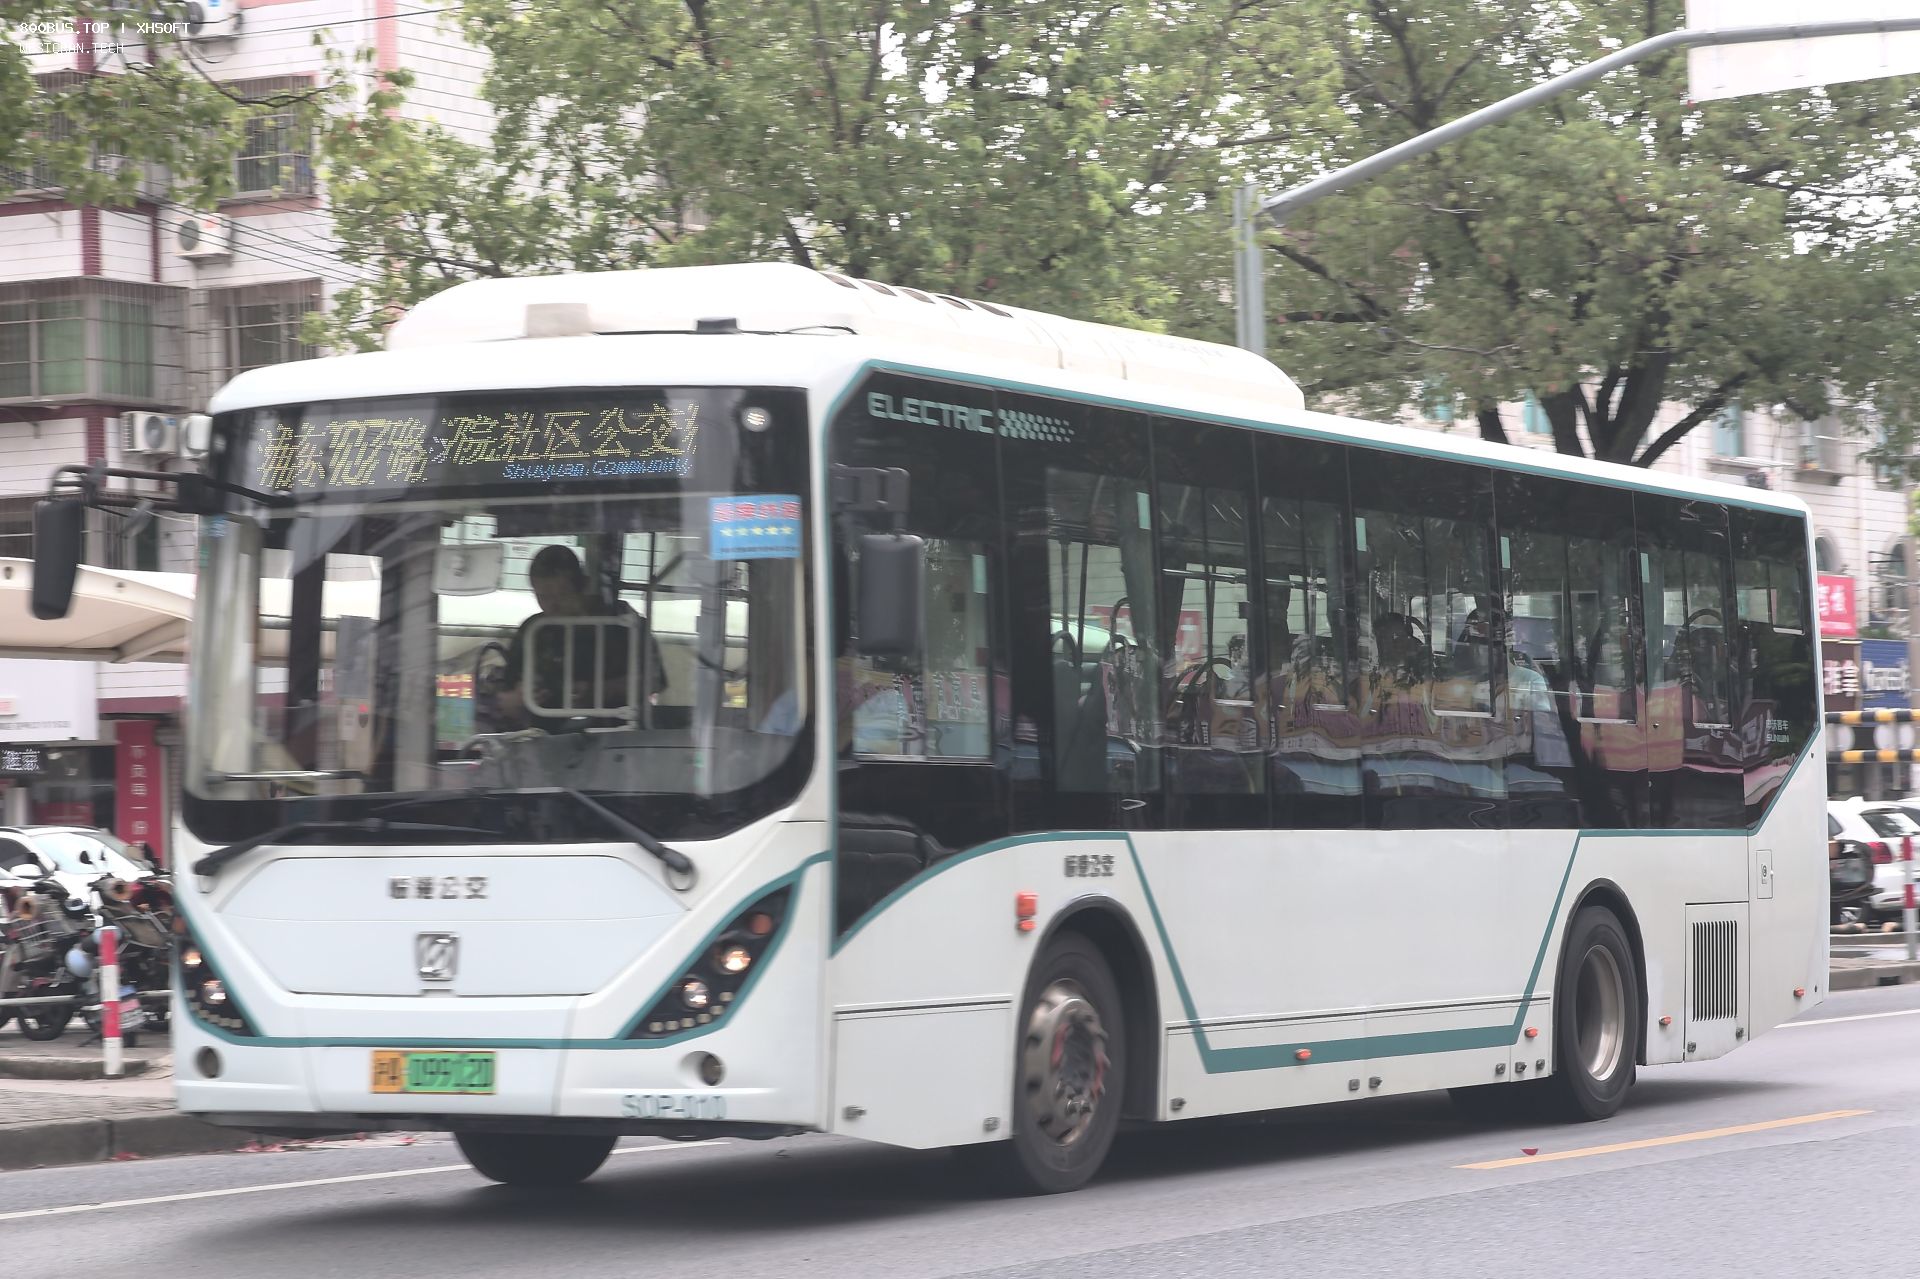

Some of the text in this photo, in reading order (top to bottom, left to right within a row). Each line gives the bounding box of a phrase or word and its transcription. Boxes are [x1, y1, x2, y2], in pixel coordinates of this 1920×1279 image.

[867, 391, 994, 434] ELECTRIC
[502, 456, 693, 482] Shuyuan Community
